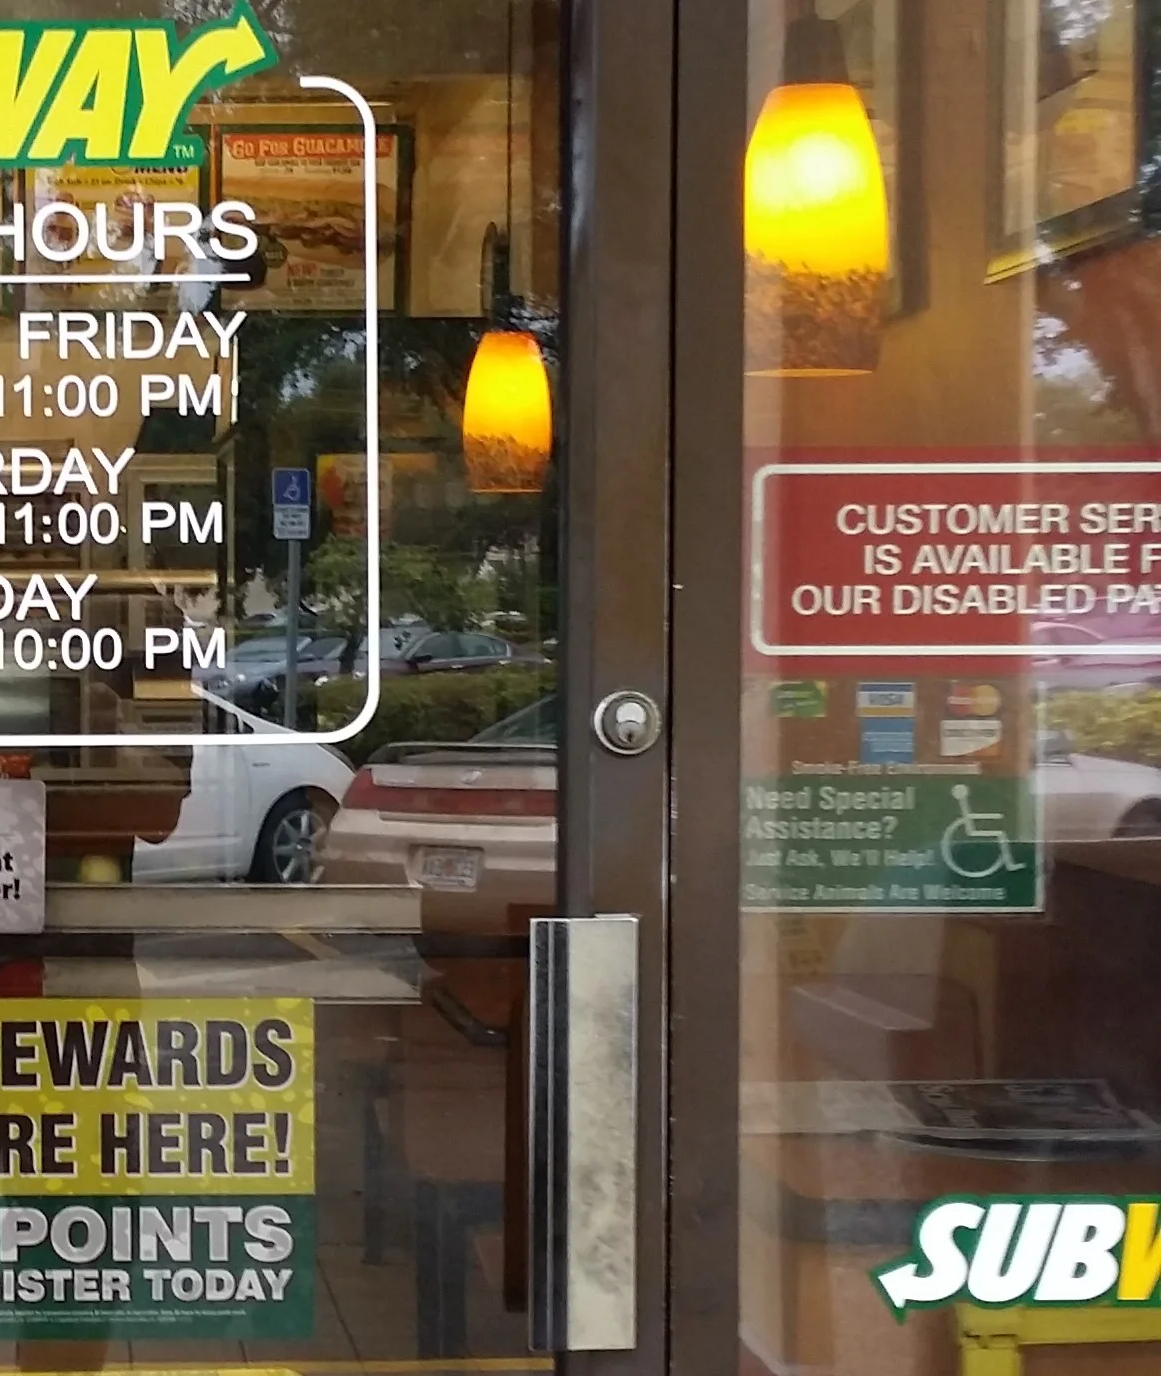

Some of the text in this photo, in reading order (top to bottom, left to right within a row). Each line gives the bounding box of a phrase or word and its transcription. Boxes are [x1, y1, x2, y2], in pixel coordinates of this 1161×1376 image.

[20, 312, 246, 361] FRIDAY
[141, 374, 221, 417] PM
[141, 501, 224, 544] PM
[836, 503, 1069, 535] CUSTOMER
[863, 544, 902, 575] IS
[911, 544, 1131, 574] AVAILABLE
[791, 584, 1161, 616] OUR DISABLED PA
[145, 627, 227, 670] PM
[744, 785, 916, 815] Need Special
[744, 815, 899, 841] Assistance?
[744, 850, 782, 867] Just
[884, 850, 936, 870] Help!
[744, 883, 1007, 901] Service Animals Are Welcome
[99, 1111, 292, 1177] HERE!
[143, 1268, 294, 1302] TODAY
